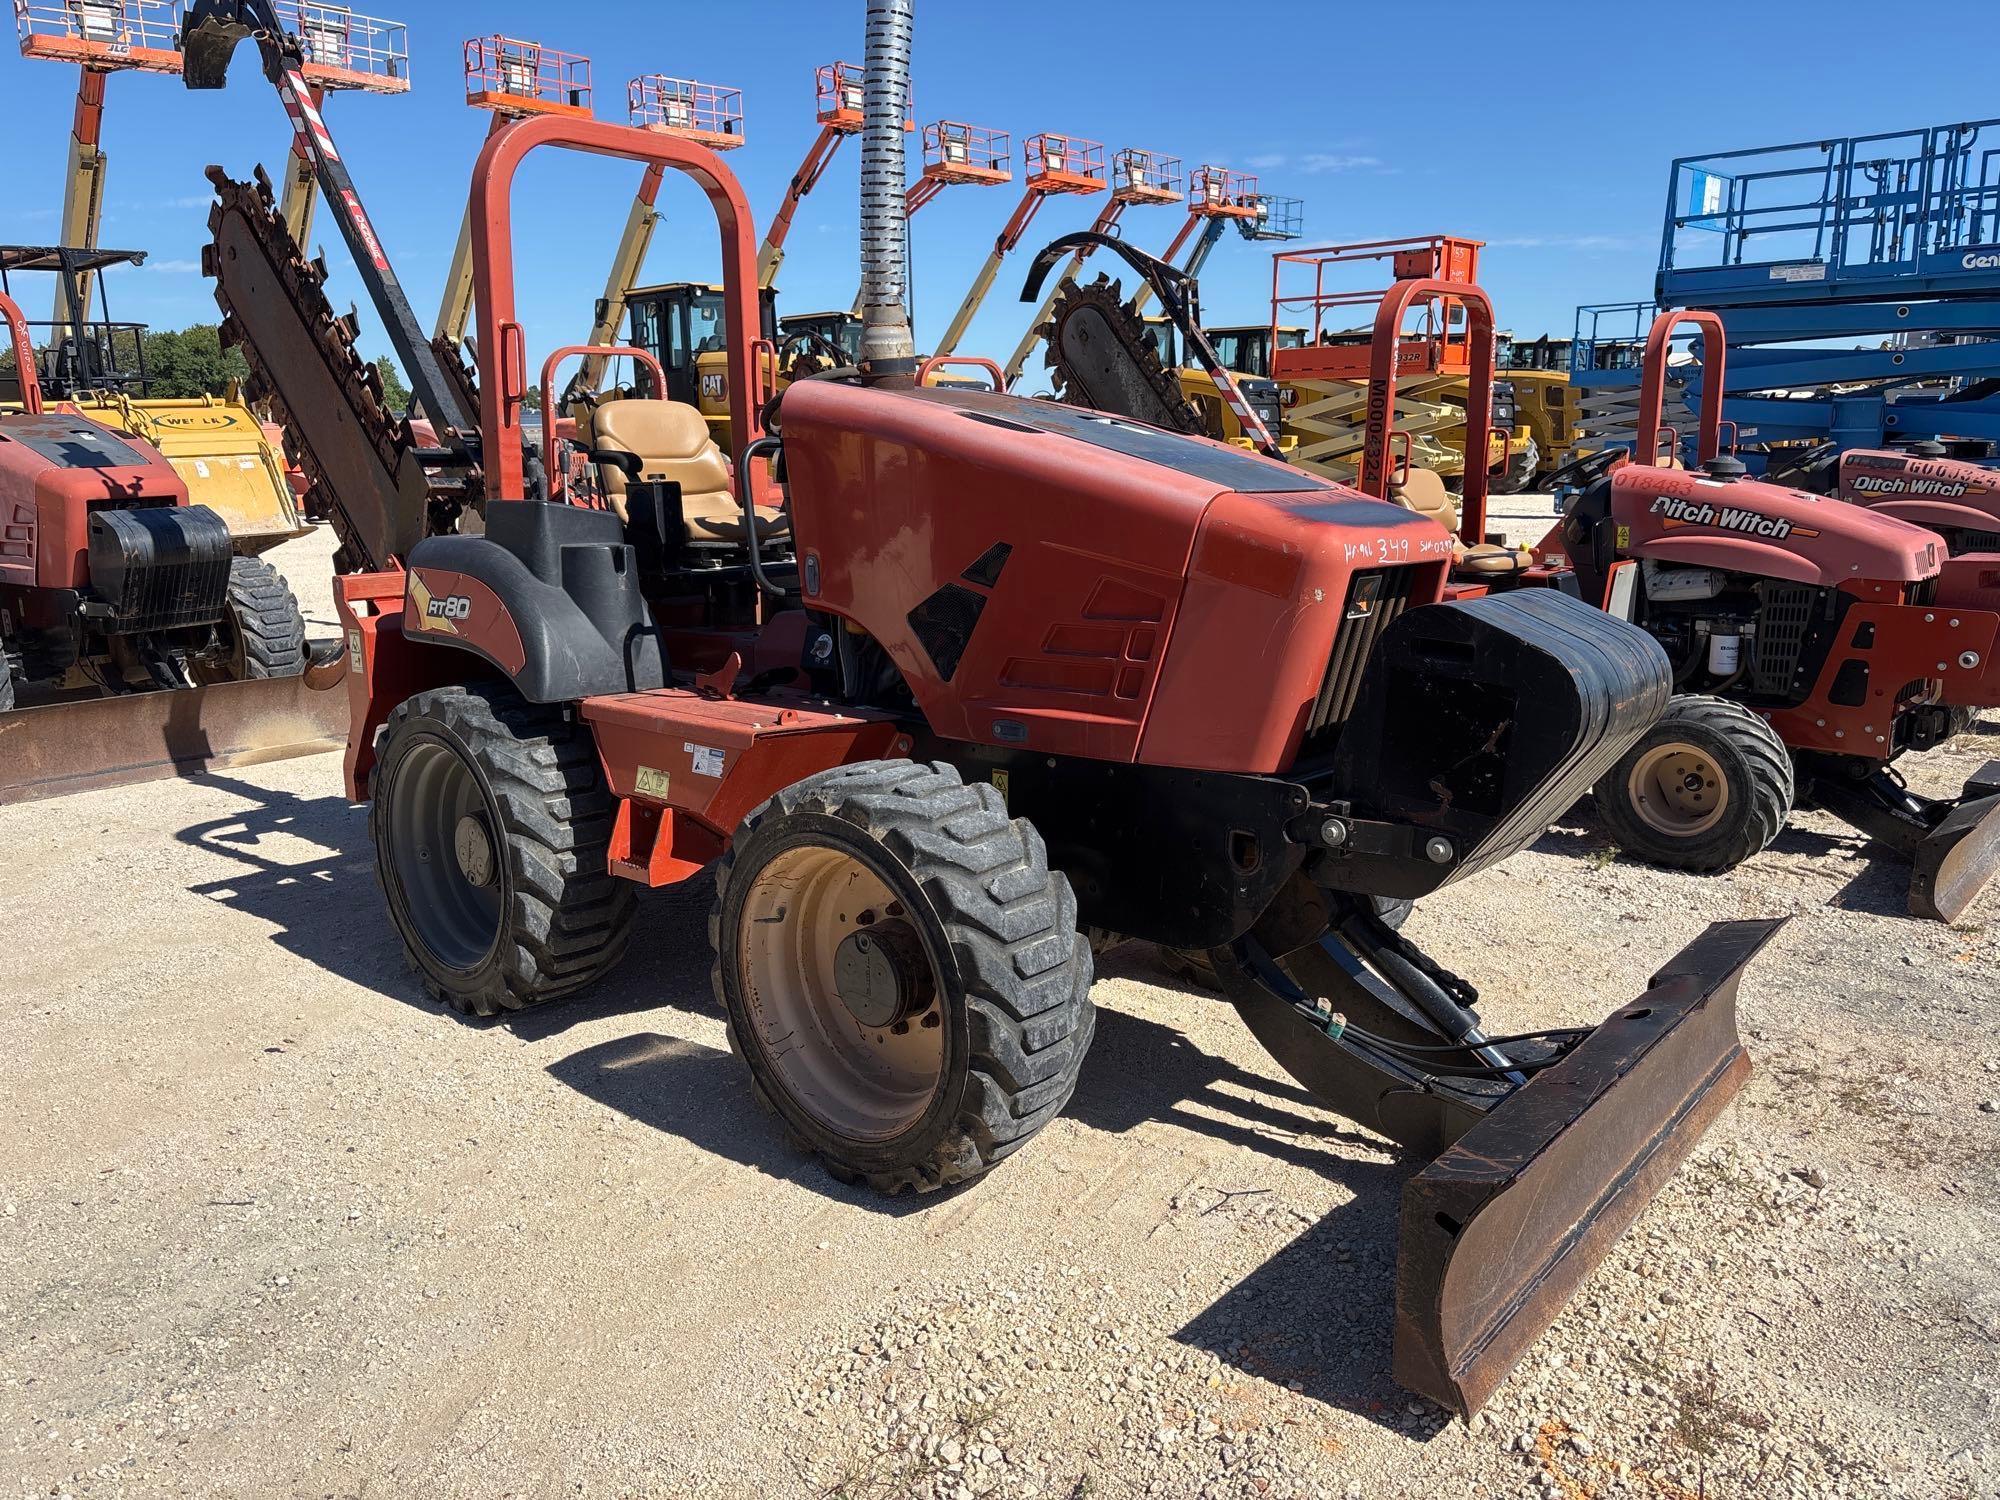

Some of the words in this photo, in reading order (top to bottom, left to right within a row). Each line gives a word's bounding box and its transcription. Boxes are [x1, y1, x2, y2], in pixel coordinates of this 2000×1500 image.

[107, 44, 130, 54] JLG
[1962, 253, 2000, 268] Gen
[1397, 353, 1421, 362] 932R
[703, 374, 722, 397] CAT
[1614, 473, 1694, 496] 018483
[1853, 476, 1905, 492] Ditch
[1910, 479, 1966, 497] Witch
[1650, 496, 1713, 524] Ditch
[1719, 507, 1791, 539] Witch
[1377, 539, 1408, 562] 349
[428, 596, 471, 618] RT80
